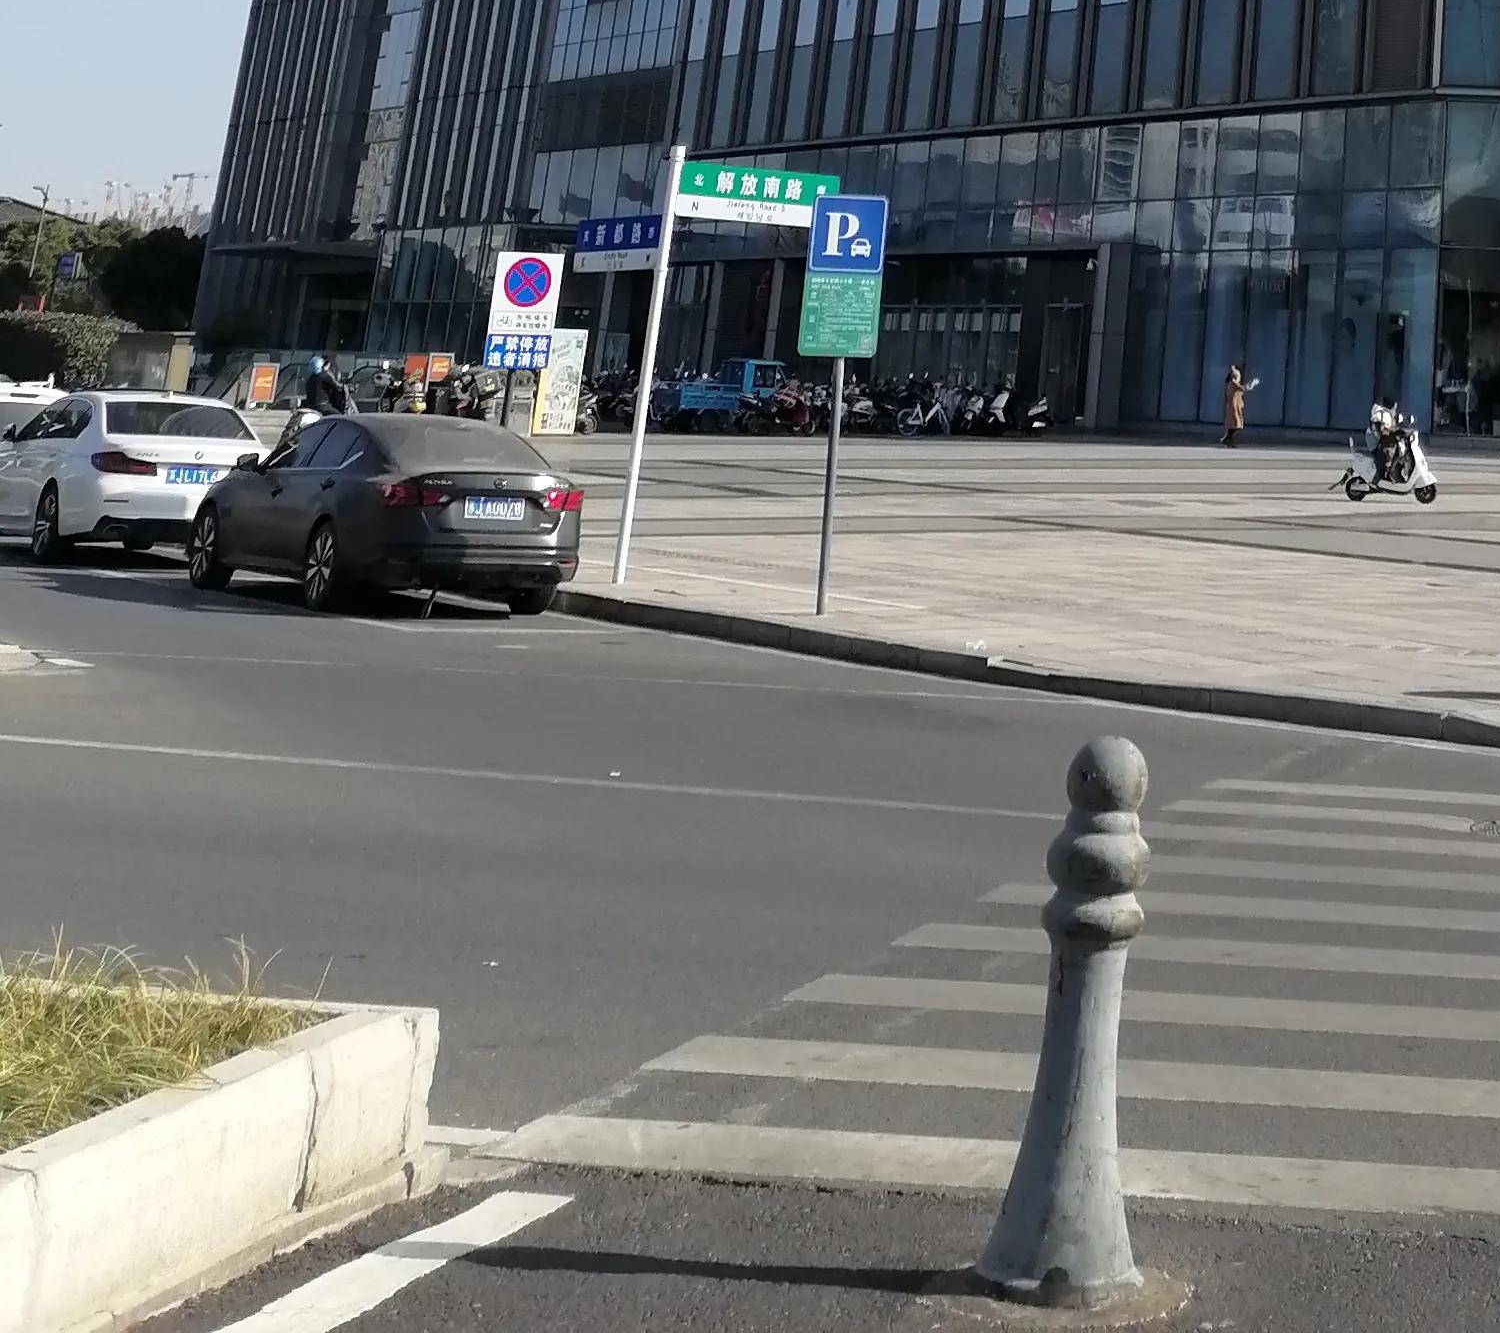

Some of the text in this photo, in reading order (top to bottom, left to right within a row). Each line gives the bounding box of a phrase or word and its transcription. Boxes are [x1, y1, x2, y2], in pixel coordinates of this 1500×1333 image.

[716, 170, 803, 201] 解放南路
[691, 201, 699, 212] N
[821, 211, 861, 257] P
[489, 335, 549, 352] 严禁停放
